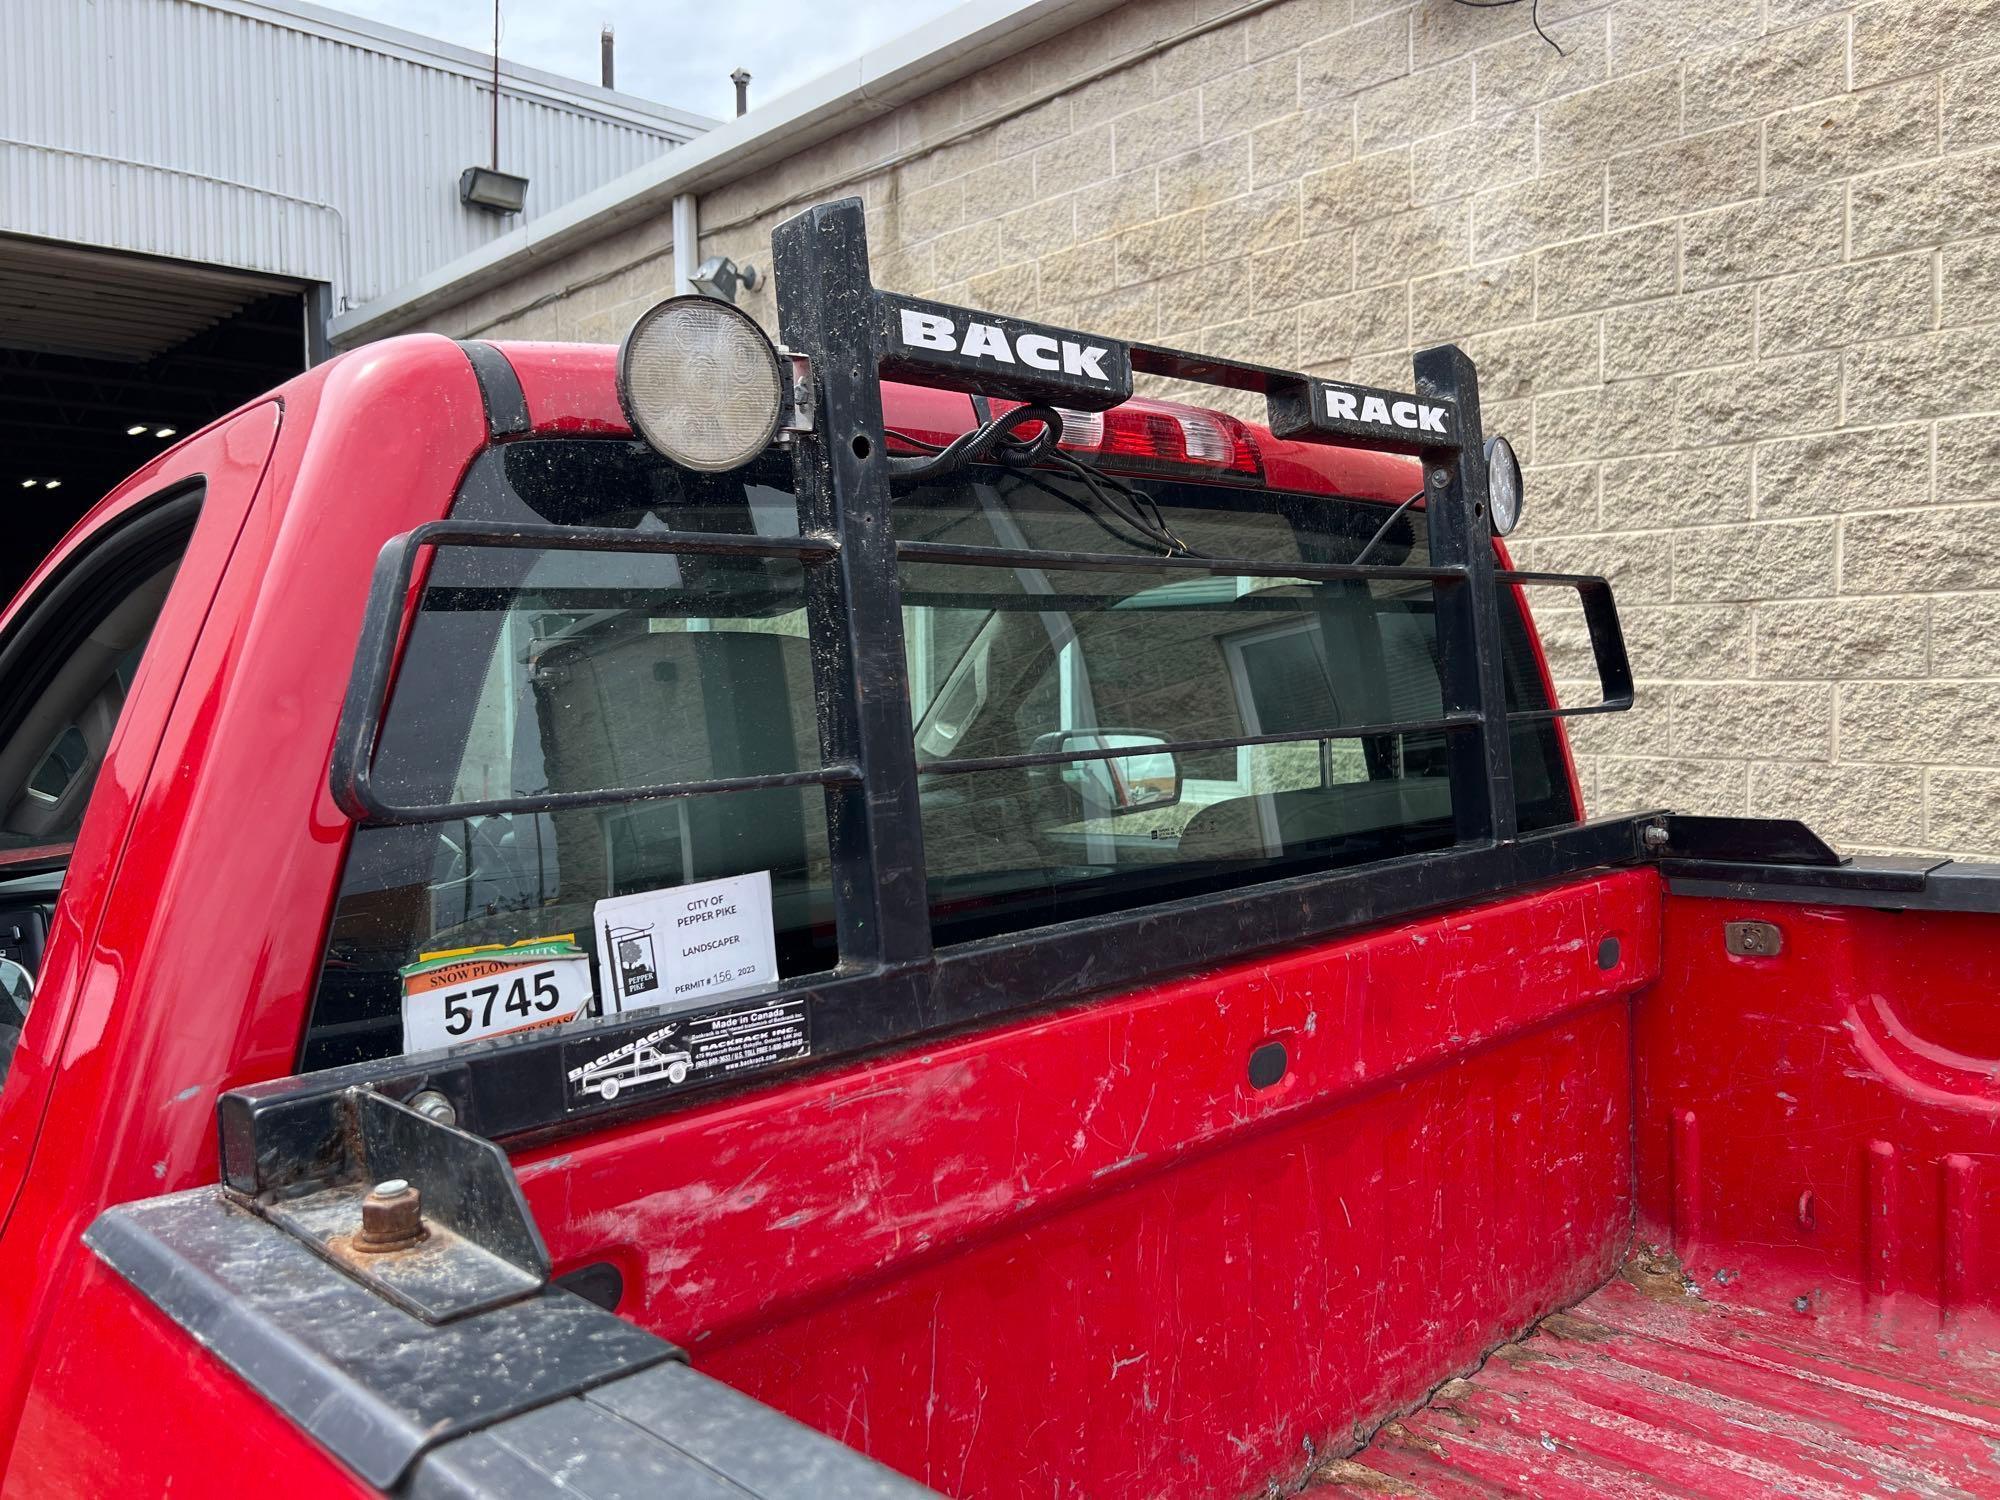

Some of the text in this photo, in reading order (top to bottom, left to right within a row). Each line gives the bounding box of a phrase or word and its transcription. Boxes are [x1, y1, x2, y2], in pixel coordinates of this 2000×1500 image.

[900, 307, 1110, 382] BACK
[1325, 389, 1449, 433] RACK
[687, 895, 724, 912] CITY OF
[677, 905, 737, 928] PEPPER PIKE
[682, 935, 740, 957] LANDSCAPER
[430, 970, 469, 987] SNOW
[473, 962, 509, 977] PLOW
[628, 972, 654, 986] PEPPER
[675, 979, 705, 994] PERMIT
[713, 970, 732, 984] 156
[737, 965, 756, 976] 2023
[629, 982, 646, 994] PIKE
[444, 970, 560, 1036] 5745
[712, 1008, 785, 1030] Made in Canada
[699, 1026, 798, 1053] BACKRACK INC.
[725, 1053, 777, 1071] www.backrack.com
